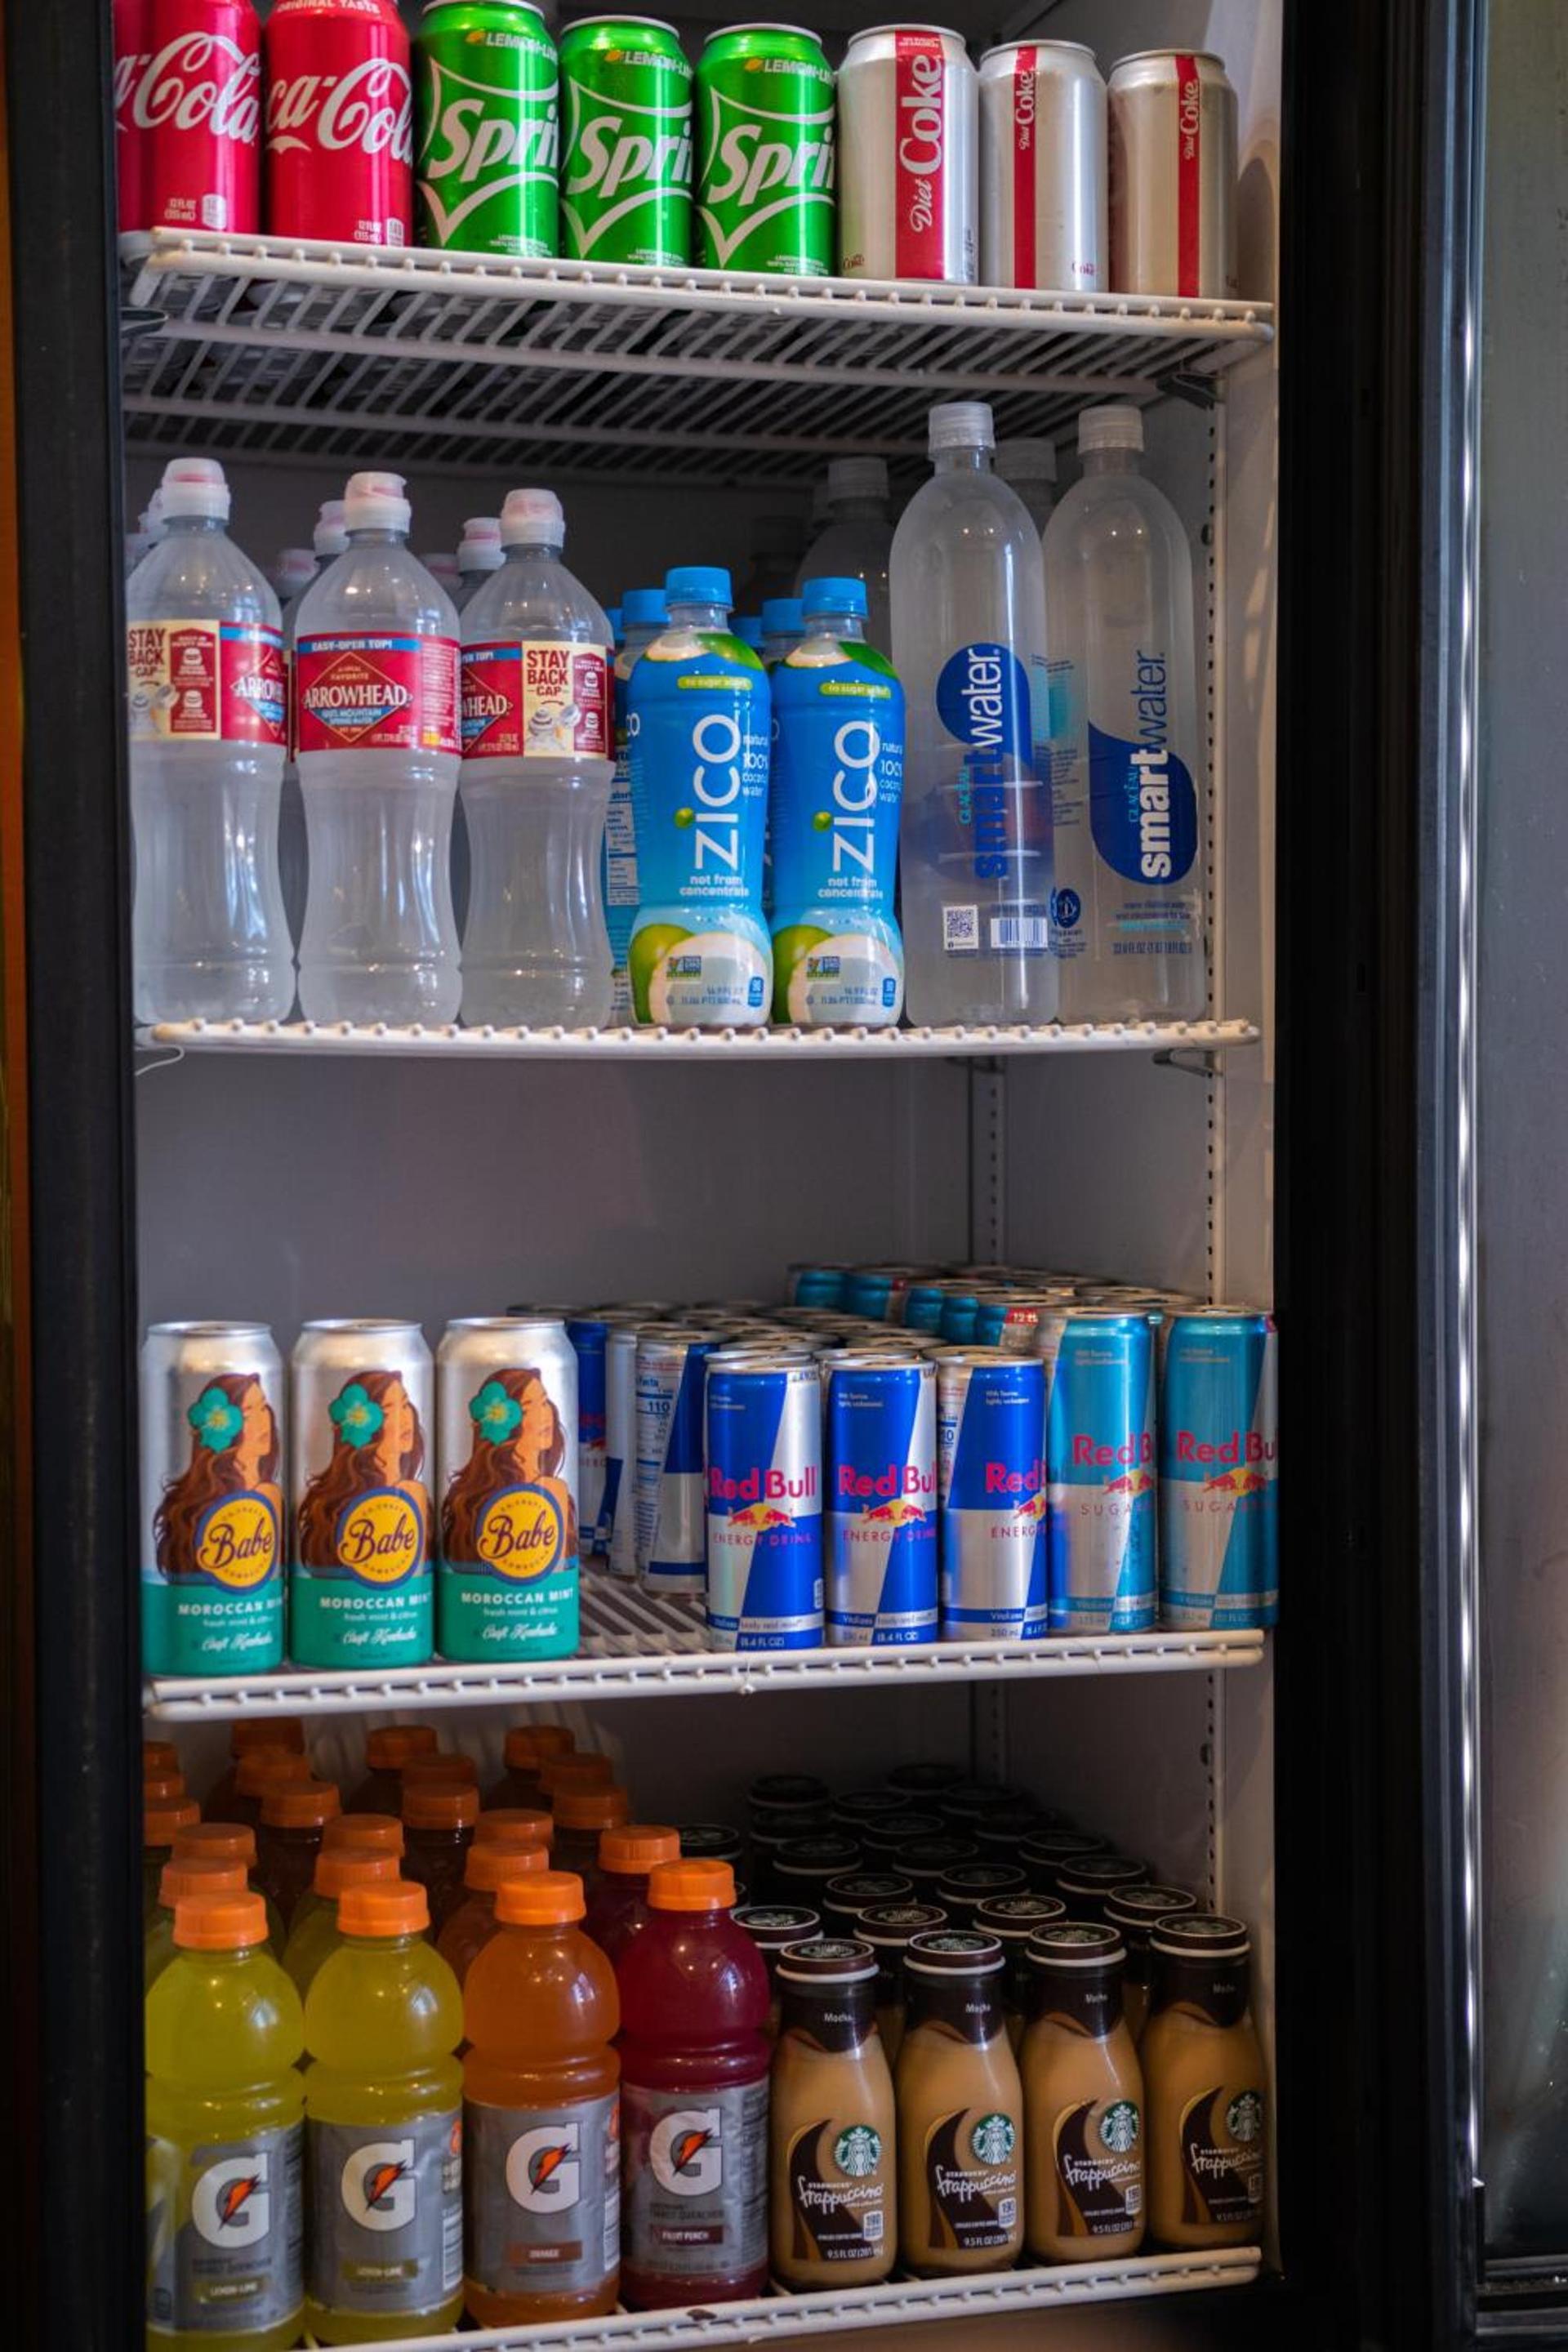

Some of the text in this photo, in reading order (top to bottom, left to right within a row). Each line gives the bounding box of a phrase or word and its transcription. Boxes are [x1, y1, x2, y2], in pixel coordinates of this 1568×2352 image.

[347, 0, 382, 14] TASTE
[899, 54, 942, 175] Coke
[1015, 69, 1036, 150] Diet Coke
[1180, 80, 1199, 135] Coke
[909, 178, 933, 233] Diet
[128, 628, 166, 648] STAY
[128, 649, 165, 666] BACK
[136, 666, 157, 677] CAP
[527, 650, 570, 669] STAY
[527, 669, 568, 686] BACK
[536, 686, 563, 697] CAP
[304, 684, 408, 708] ARROWHEAD
[693, 714, 742, 871] ZICO
[833, 720, 880, 873] ZICO
[690, 874, 742, 885] not from
[828, 877, 849, 888] not
[648, 1401, 670, 1412] 110
[1073, 1432, 1136, 1467] Red
[1178, 1431, 1240, 1463] Red
[708, 1466, 817, 1499] Red Bull
[840, 1464, 896, 1497] Red
[985, 1460, 1040, 1494] Red
[199, 1517, 273, 1570] Babe
[341, 1512, 416, 1564] Babe
[479, 1510, 555, 1559] Babe
[713, 1533, 812, 1547] ENERGY DRINK
[843, 1529, 900, 1543] ENERGY
[178, 1602, 264, 1615] MOROCCAN
[320, 1597, 406, 1609] MOROCCAN
[461, 1592, 544, 1604] MOROCCAN
[824, 2012, 853, 2024] Mocha
[649, 2107, 723, 2196] G
[341, 2138, 416, 2232] G
[506, 2123, 581, 2214] G
[935, 2164, 1017, 2203] frappuccino
[192, 2153, 270, 2248] G
[798, 2175, 884, 2215] frappuccino
